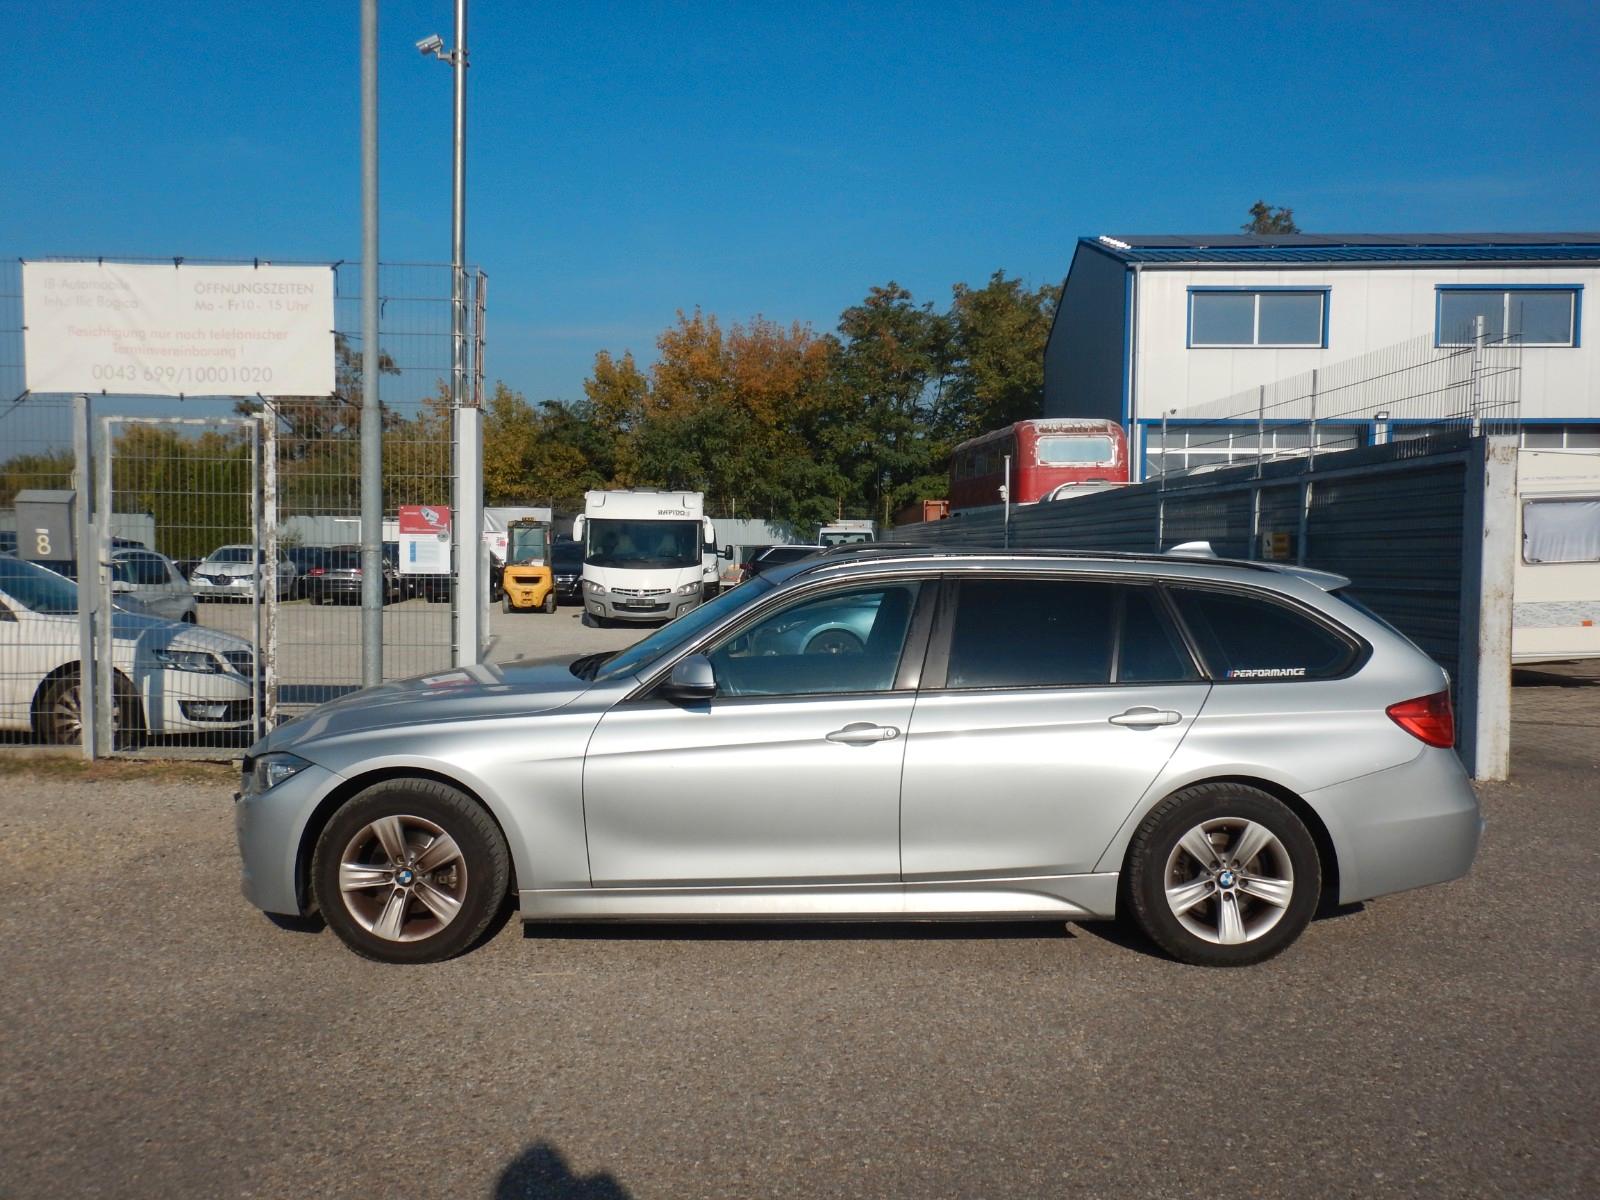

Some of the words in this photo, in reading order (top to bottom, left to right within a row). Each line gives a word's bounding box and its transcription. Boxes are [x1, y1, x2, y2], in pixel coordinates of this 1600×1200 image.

[194, 281, 314, 296] ÖFFNUNGSZEITEN
[194, 300, 215, 312] Mo
[268, 299, 283, 311] 15
[286, 299, 311, 313] Uhr
[149, 329, 172, 341] nur
[92, 364, 137, 381] 0043
[144, 364, 273, 385] 699/10001020
[37, 534, 52, 555] 8
[1232, 667, 1307, 678] PERFORMANCE
